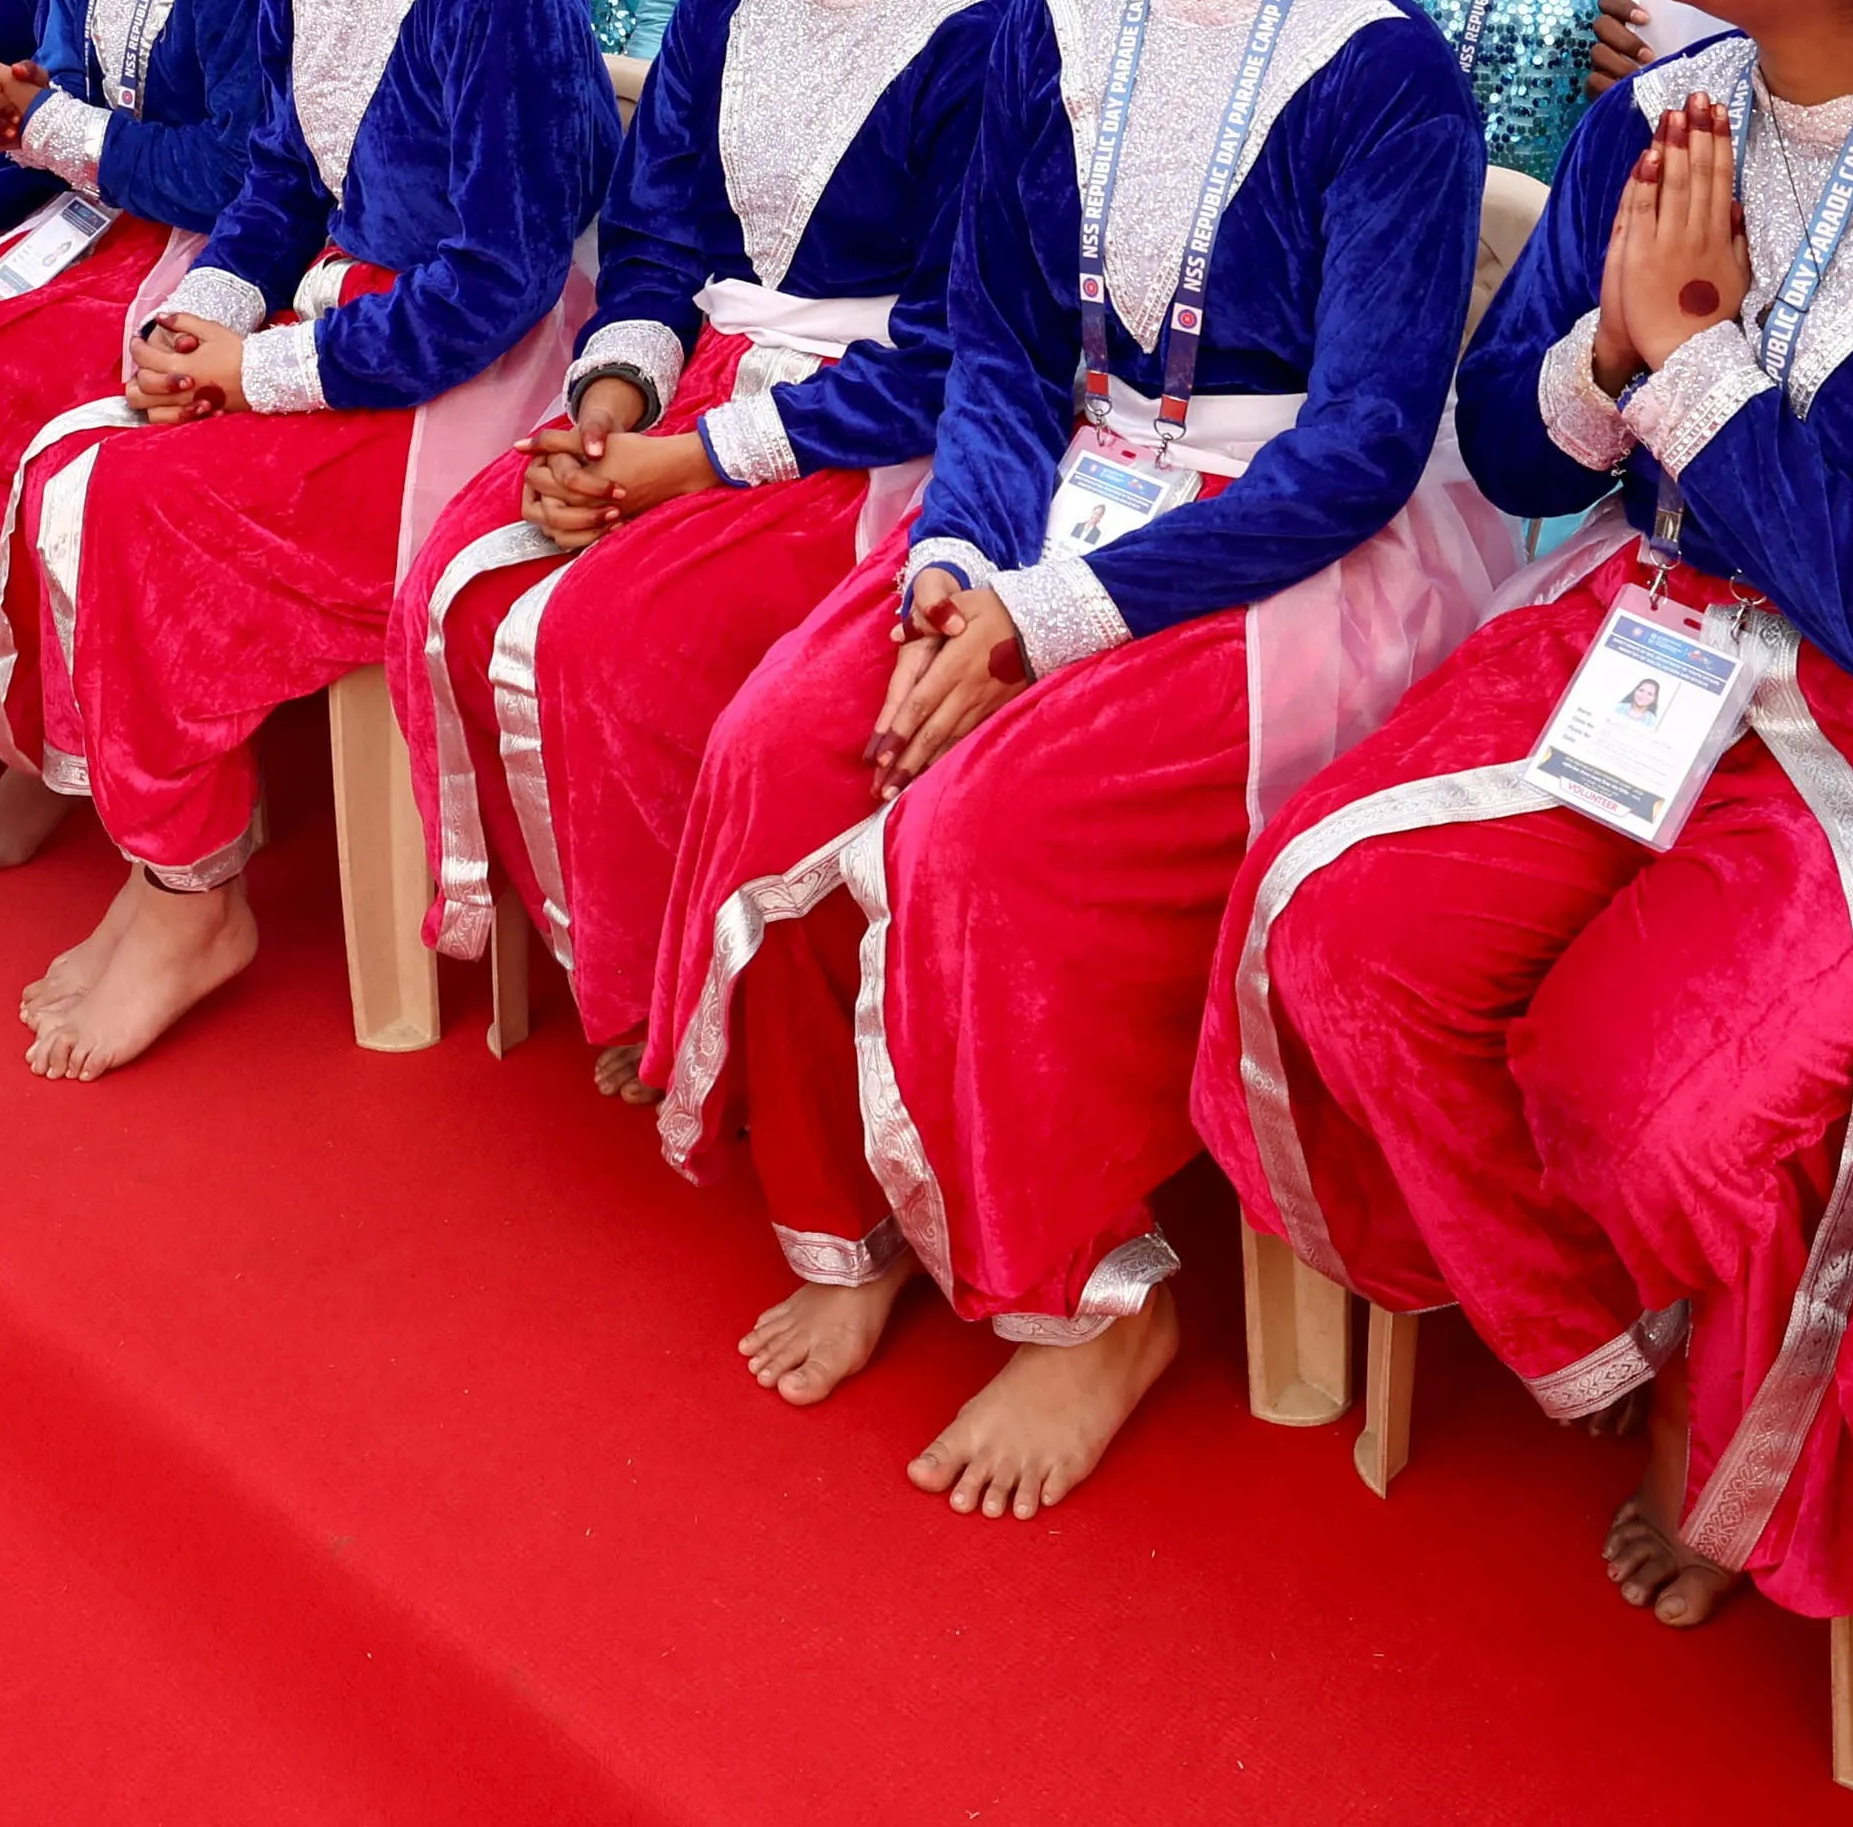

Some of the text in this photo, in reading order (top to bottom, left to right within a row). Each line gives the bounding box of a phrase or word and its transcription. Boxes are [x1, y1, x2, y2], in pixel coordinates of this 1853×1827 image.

[1251, 2, 1281, 56] CAMP
[125, 51, 137, 78] NSS
[1113, 23, 1142, 95] PARADE
[1460, 44, 1477, 73] NSS
[1228, 48, 1264, 132] PARADE
[1731, 78, 1750, 132] CAMP
[1102, 96, 1125, 140] DAY
[1216, 124, 1241, 172] DAY
[1088, 135, 1116, 219] REPUBLIC
[1192, 165, 1227, 257] REPUBLIC
[1082, 219, 1100, 259] NSS
[1182, 252, 1205, 293] NSS
[1765, 303, 1800, 382] PUBLIC
[1784, 264, 1819, 314] DAY
[1804, 182, 1853, 270] PARADE
[1568, 780, 1618, 813] VOLUNTEER
